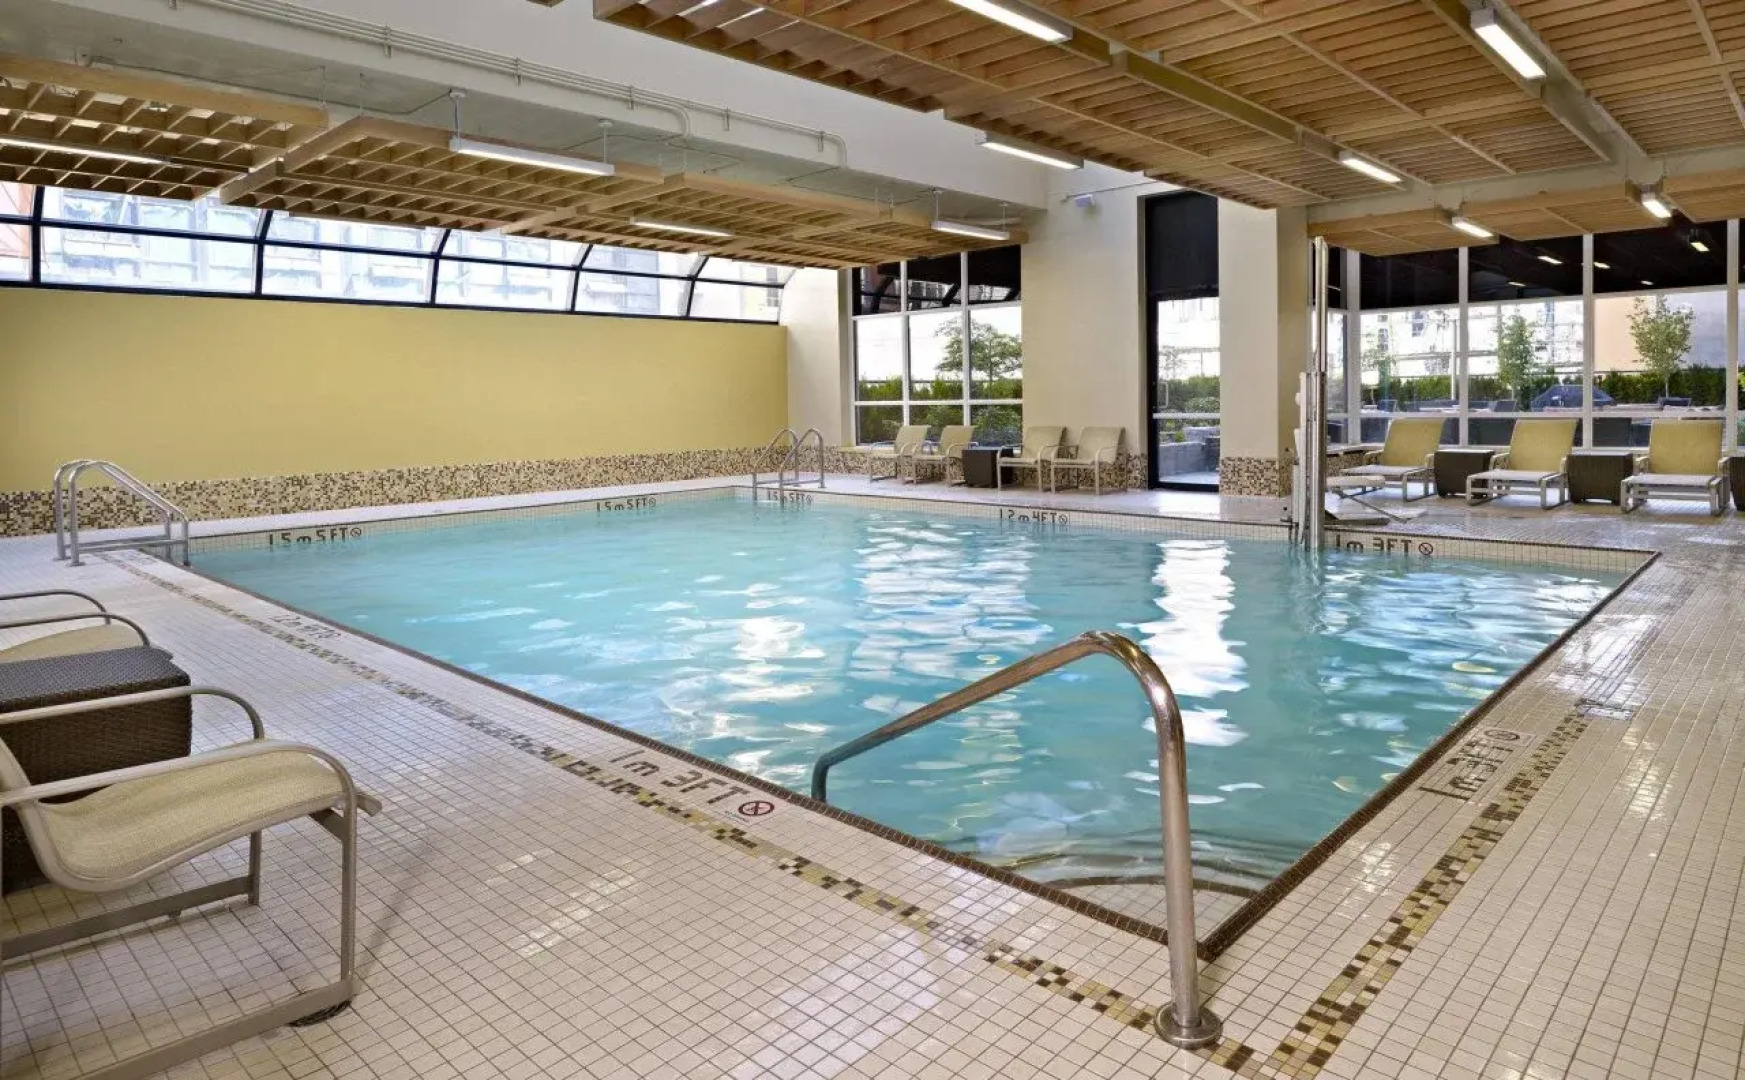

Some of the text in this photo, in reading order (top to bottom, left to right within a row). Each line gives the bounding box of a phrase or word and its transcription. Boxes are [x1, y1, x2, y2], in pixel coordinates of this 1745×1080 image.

[1032, 510, 1057, 523] 4FT
[608, 750, 750, 804] 1m 3FT
